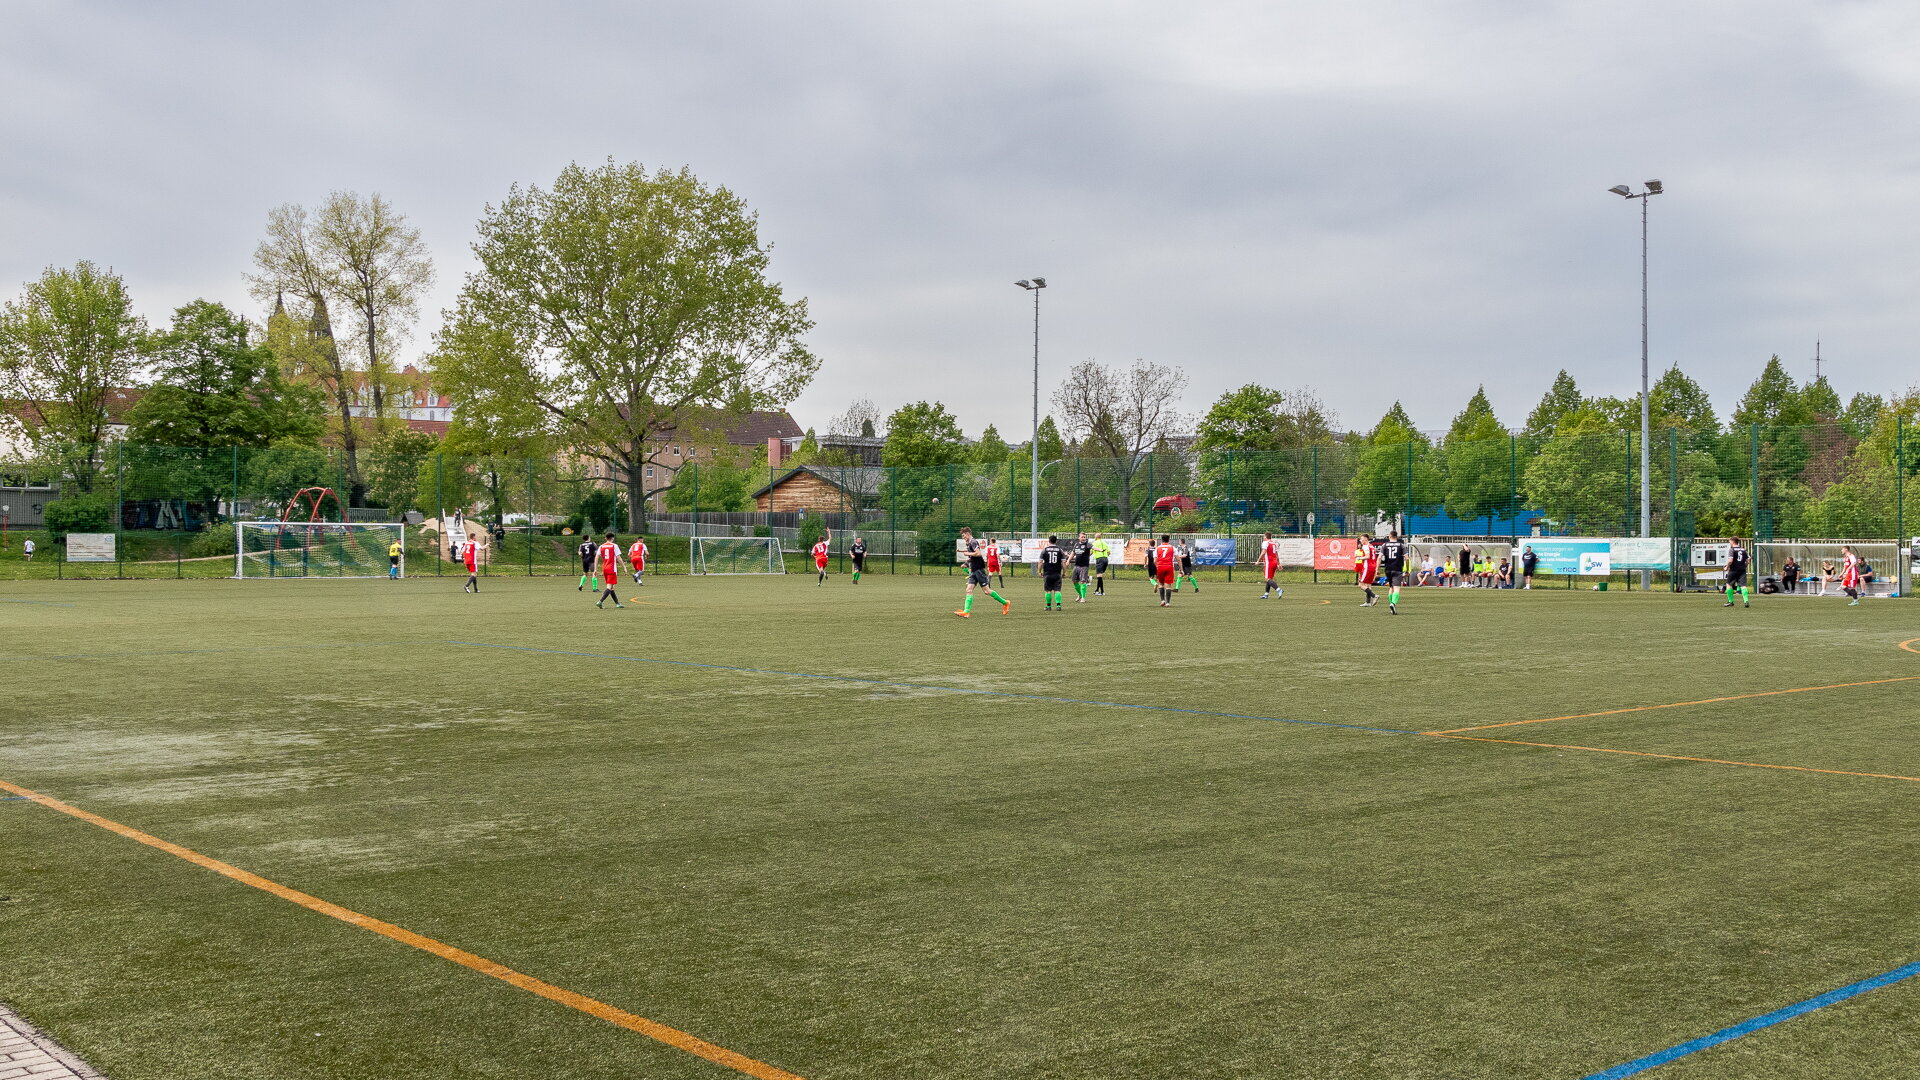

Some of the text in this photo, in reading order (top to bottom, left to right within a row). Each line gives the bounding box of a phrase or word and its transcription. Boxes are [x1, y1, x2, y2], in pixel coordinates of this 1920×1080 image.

[466, 545, 471, 553] 2
[584, 544, 590, 554] 5
[604, 549, 610, 559] 9
[1161, 548, 1168, 558] 7
[1387, 547, 1397, 559] 12
[1048, 552, 1058, 563] 16
[1737, 551, 1742, 561] 6
